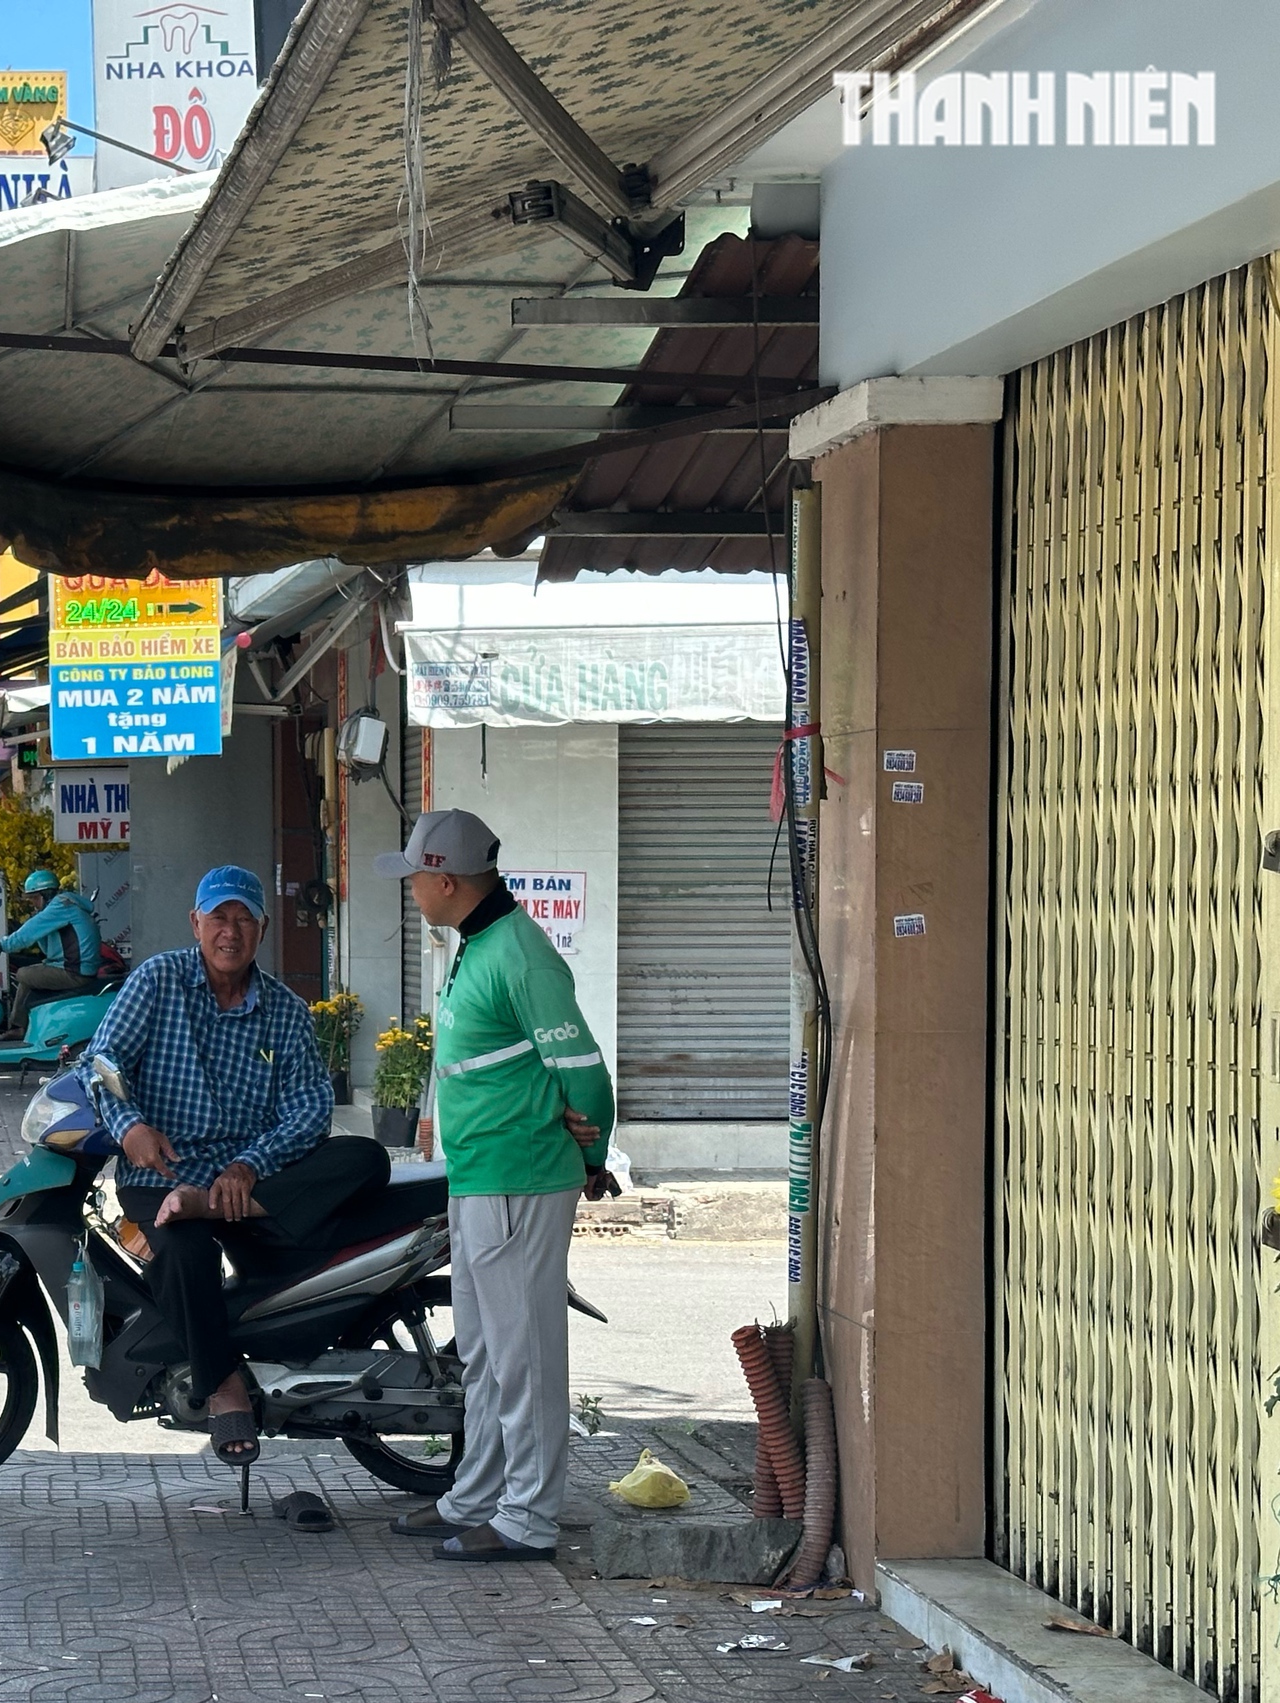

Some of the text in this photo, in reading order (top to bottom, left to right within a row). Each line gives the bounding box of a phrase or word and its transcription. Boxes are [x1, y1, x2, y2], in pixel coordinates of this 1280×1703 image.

[106, 60, 255, 80] NHA KHOA
[11, 82, 59, 104] VÀNG
[65, 597, 140, 624] 24/24
[56, 633, 215, 659] BÁN BẢO HIỂM XE
[59, 664, 214, 683] CÔNG TY BẢO LONG
[577, 650, 668, 712] HÀNG
[58, 683, 216, 708] MUA 2 NĂM
[107, 711, 166, 729] tặng
[81, 731, 195, 754] 1 NĂM
[61, 778, 99, 814] NHÀ
[78, 818, 112, 840] MỸ
[532, 875, 572, 891] BÁN
[532, 900, 549, 918] XE
[553, 895, 581, 919] MÁY
[533, 1021, 579, 1043] Grab
